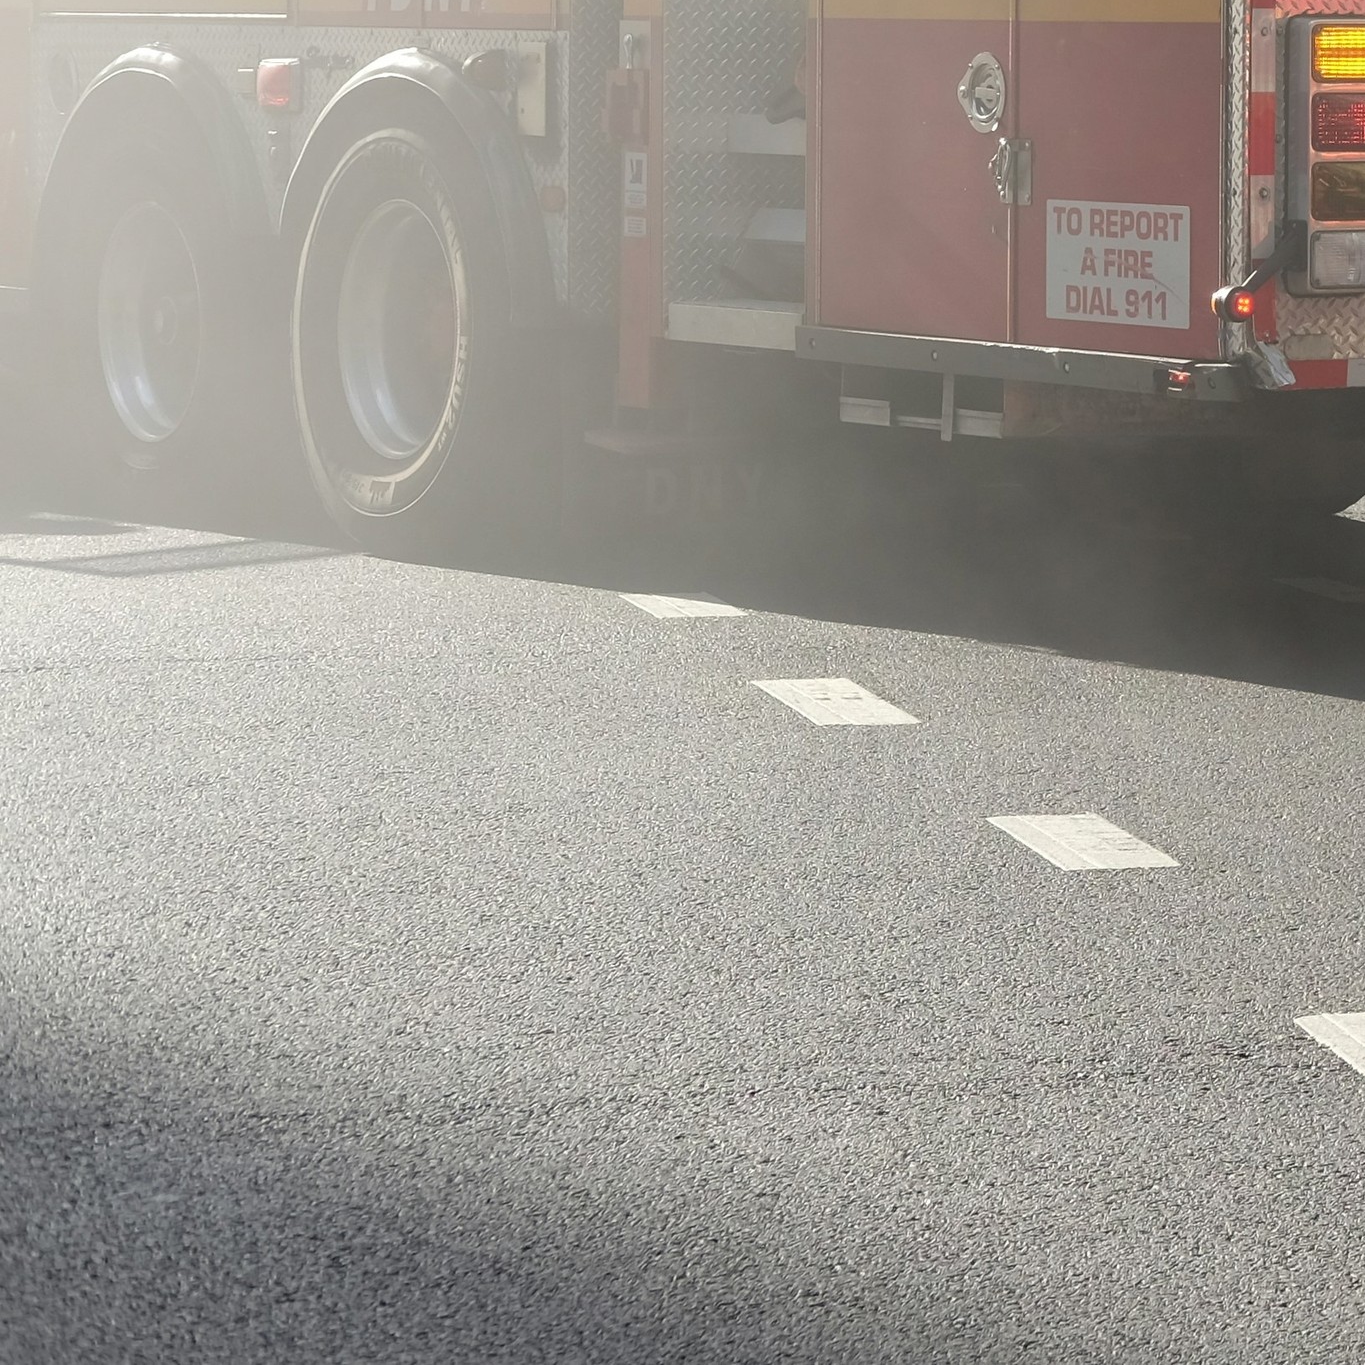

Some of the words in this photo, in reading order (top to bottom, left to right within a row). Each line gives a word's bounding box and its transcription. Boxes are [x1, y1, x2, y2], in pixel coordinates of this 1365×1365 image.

[1053, 206, 1082, 236] TO
[1089, 208, 1184, 242] REPORT
[1080, 247, 1097, 276] A
[1104, 248, 1154, 280] FIRE
[1065, 285, 1119, 317] DIAL
[1125, 288, 1167, 321] 911
